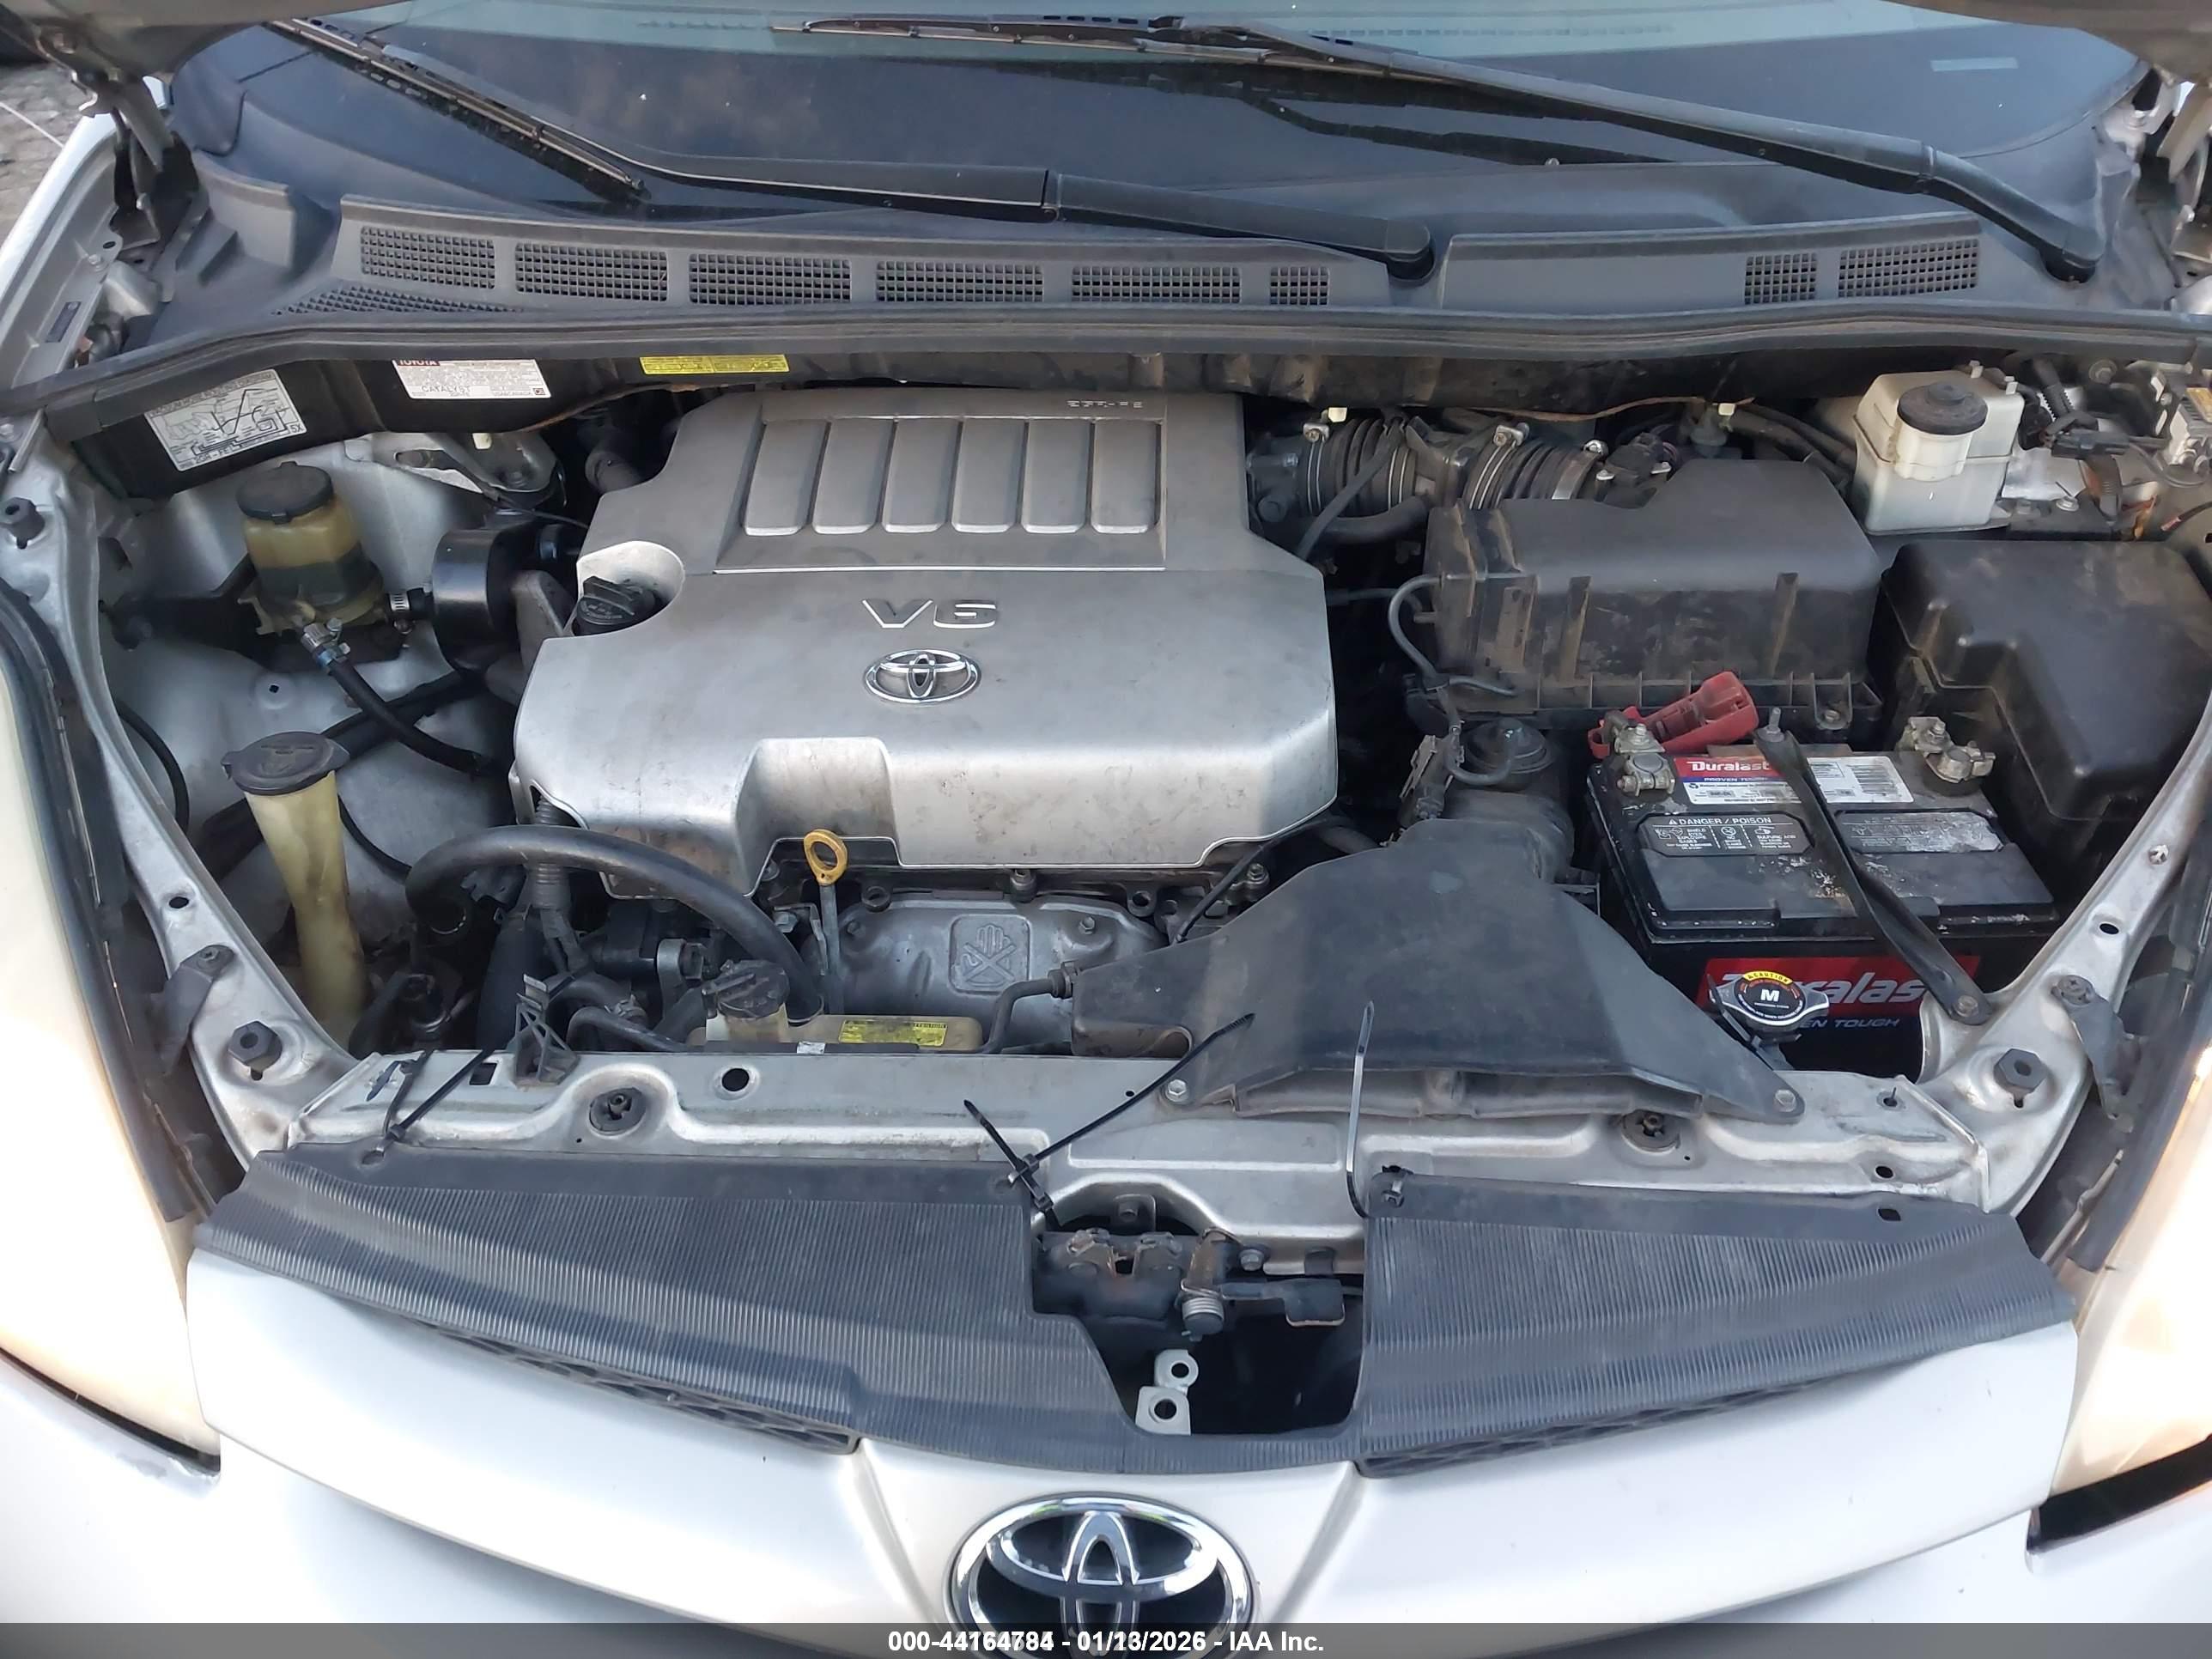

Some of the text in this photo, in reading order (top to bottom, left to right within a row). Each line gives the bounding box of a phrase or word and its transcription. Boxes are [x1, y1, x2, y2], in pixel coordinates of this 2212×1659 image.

[861, 599, 997, 629] V6
[1686, 761, 1771, 771] Duralast
[1753, 972, 1789, 983] CAUTION
[1760, 988, 1780, 1002] M
[1835, 1018, 1900, 1028] TOUGH
